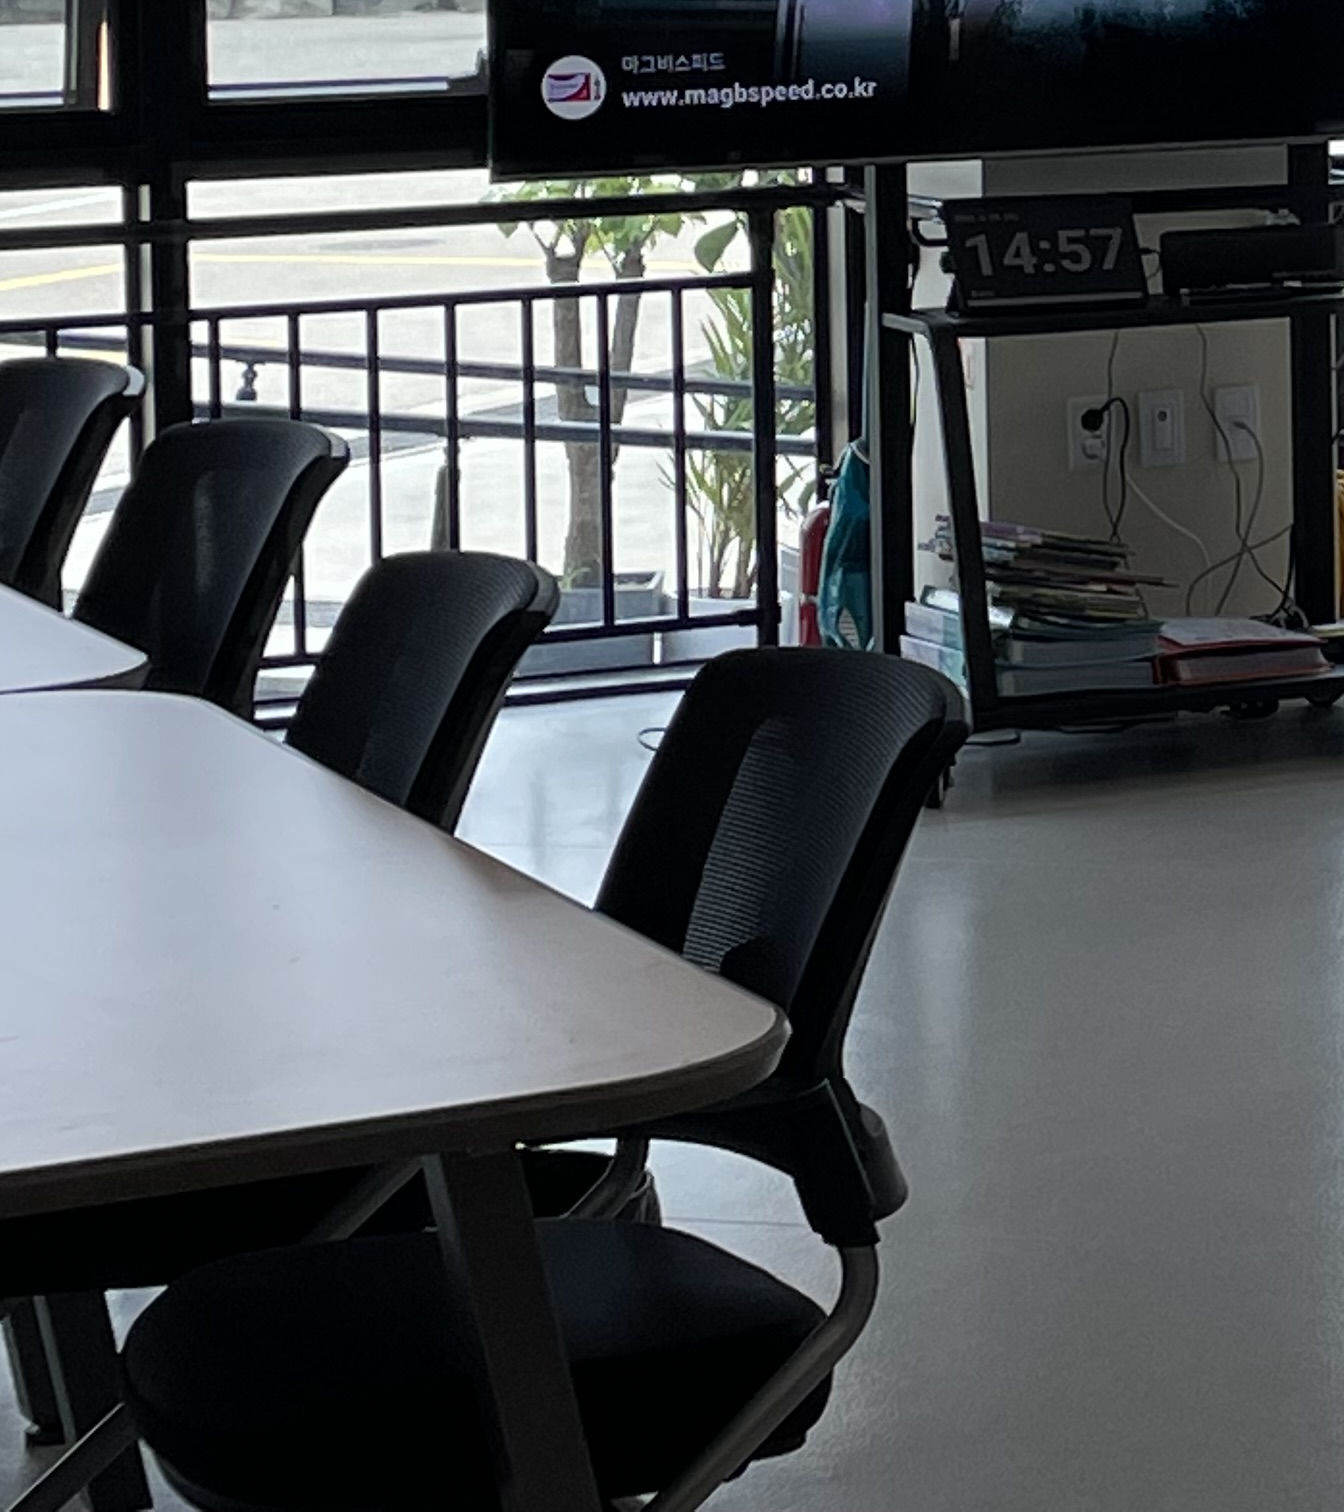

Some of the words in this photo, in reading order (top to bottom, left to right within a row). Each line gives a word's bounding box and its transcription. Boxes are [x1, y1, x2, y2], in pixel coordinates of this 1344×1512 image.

[622, 52, 726, 75] 마그비스피드
[622, 77, 877, 108] www.magbspeed.co.kr
[965, 228, 1122, 277] 14:57
